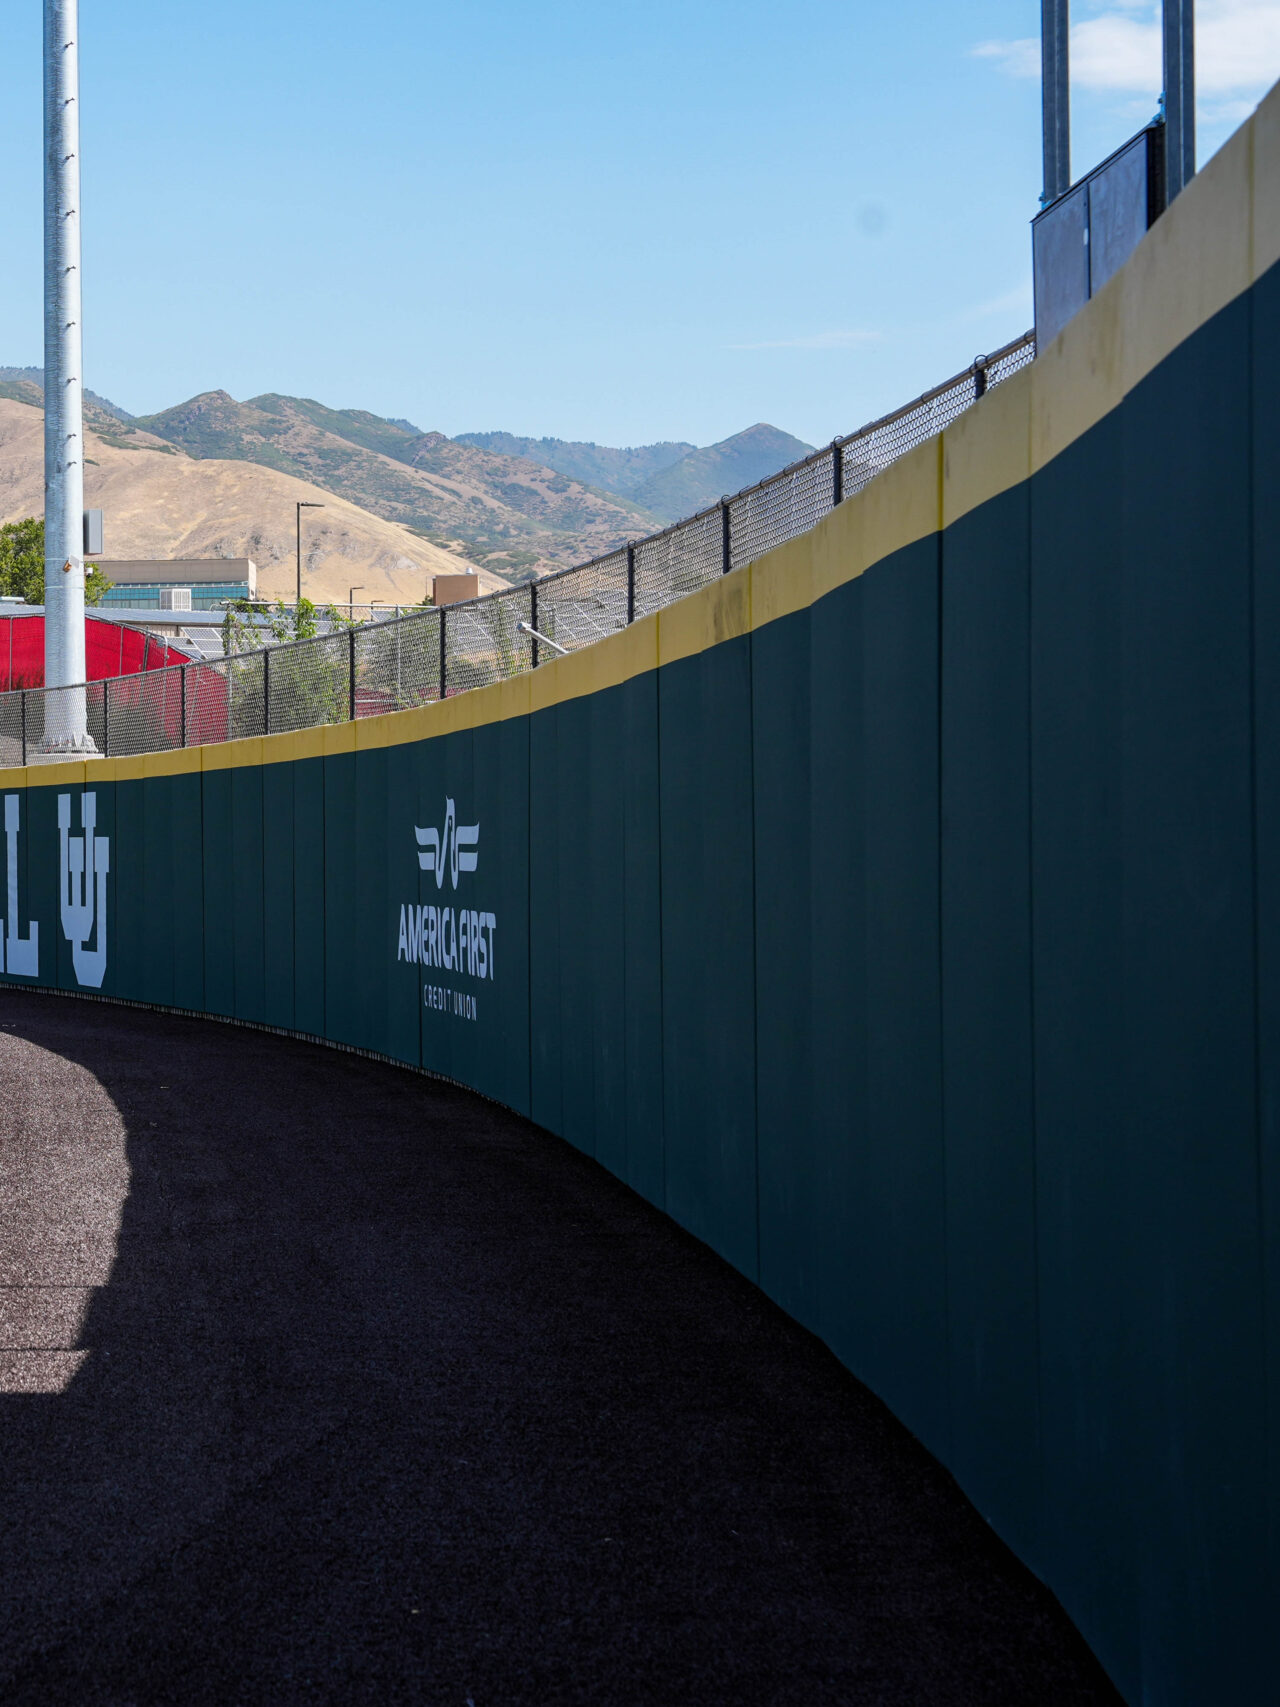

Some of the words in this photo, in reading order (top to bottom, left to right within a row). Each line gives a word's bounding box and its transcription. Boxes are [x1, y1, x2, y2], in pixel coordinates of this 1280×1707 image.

[399, 905, 458, 971] AMERICA
[460, 910, 496, 980] FIRST
[425, 985, 451, 1012] CREDIT
[455, 993, 477, 1021] UNION
